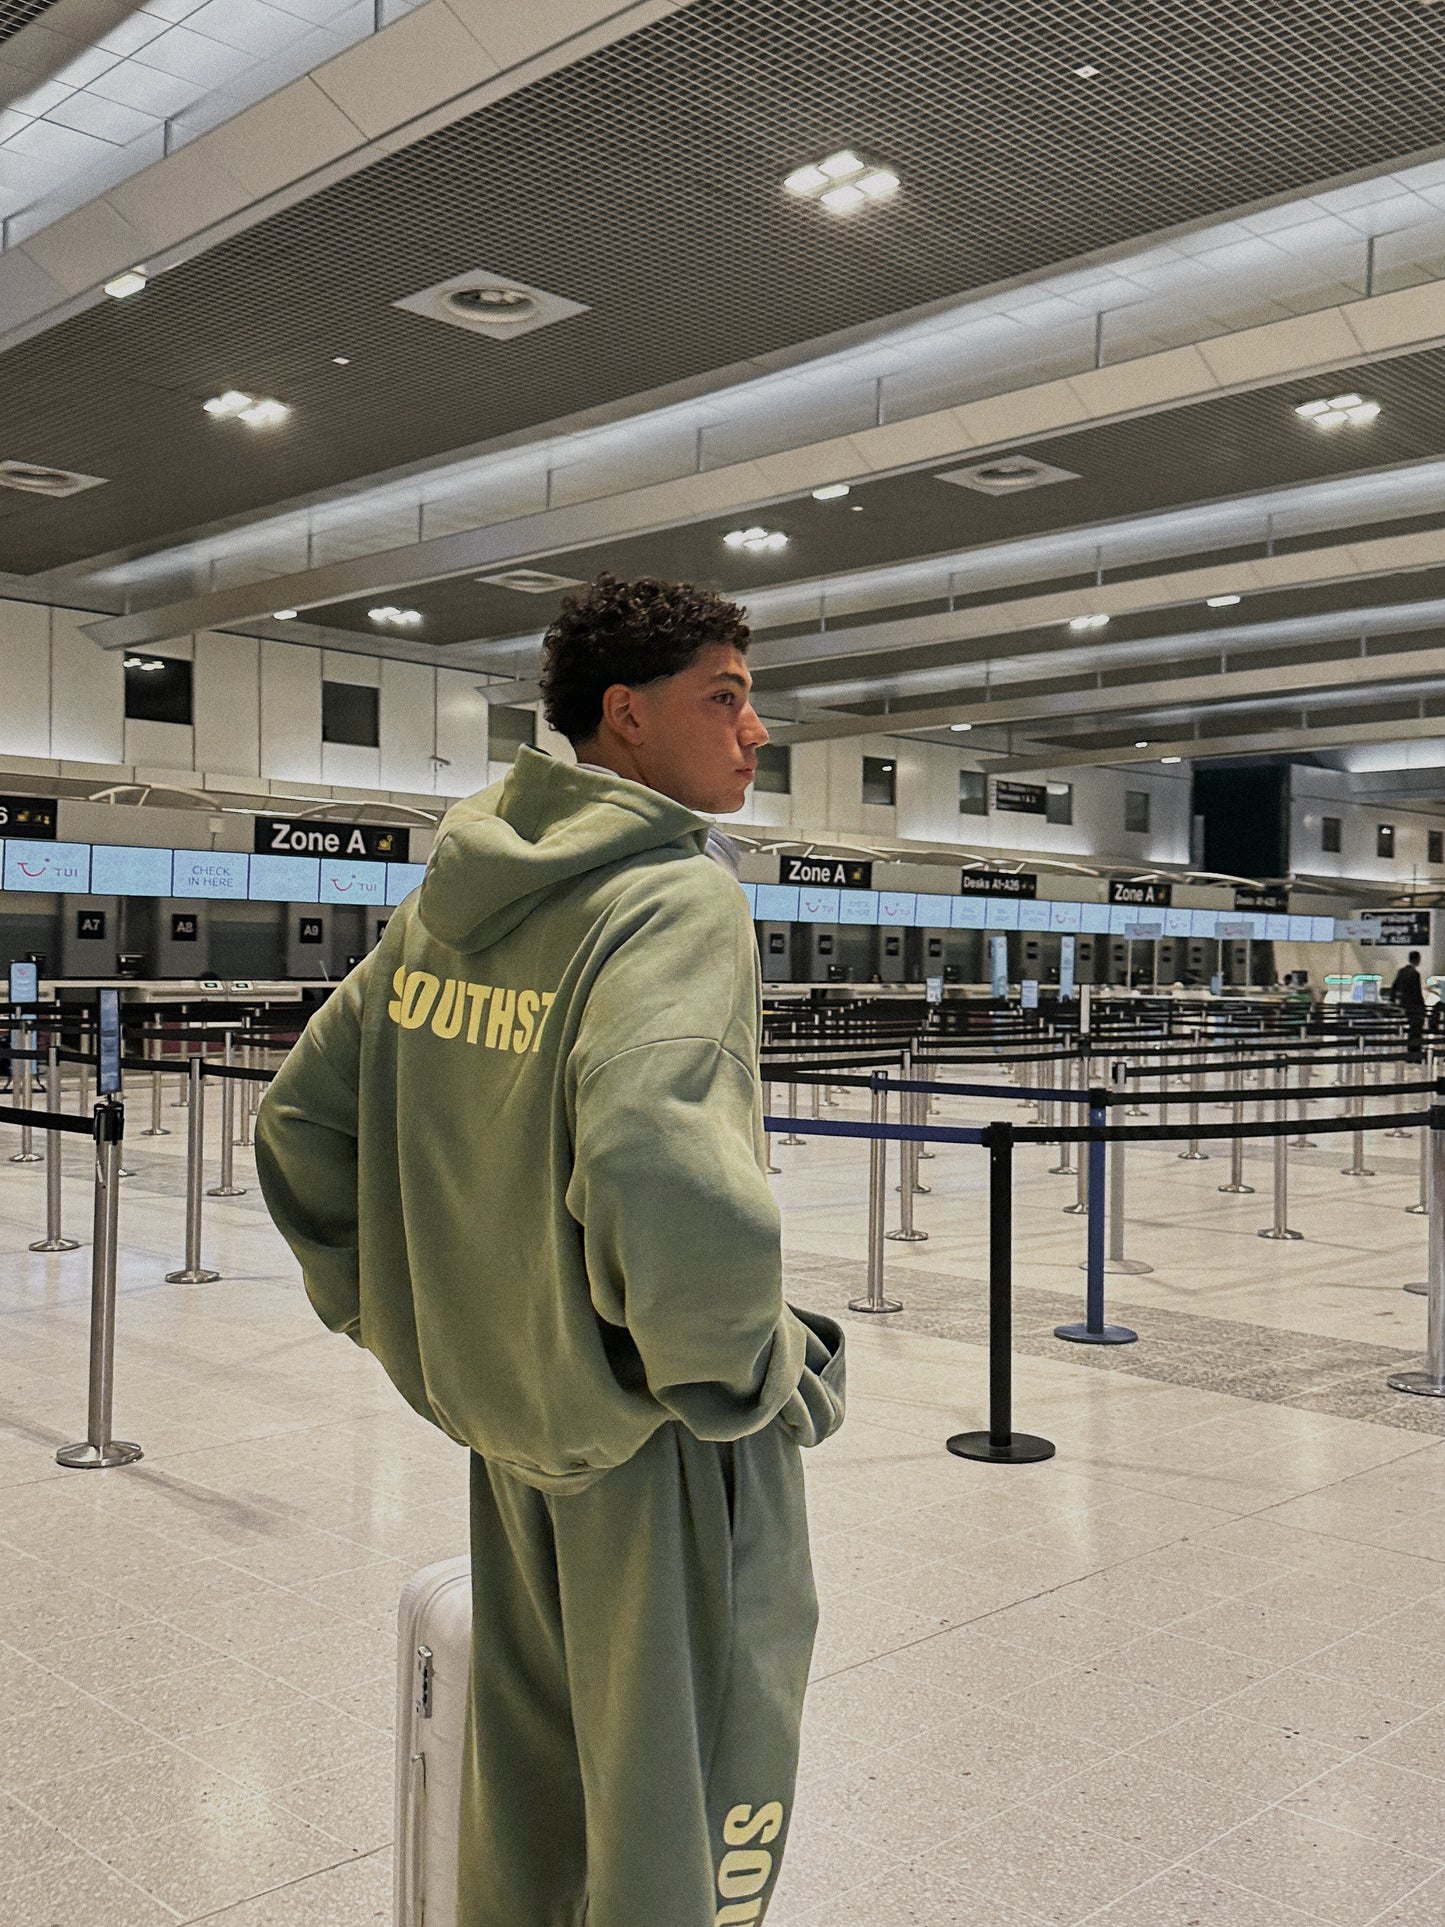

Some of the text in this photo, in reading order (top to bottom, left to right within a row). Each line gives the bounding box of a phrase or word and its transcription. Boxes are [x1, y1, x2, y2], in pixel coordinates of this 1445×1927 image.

[271, 823, 366, 854] Zone A
[54, 867, 78, 877] TUI
[192, 865, 231, 876] CHECK
[789, 861, 846, 883] Zone A
[188, 877, 233, 887] IN HERE
[357, 882, 377, 891] TUI
[963, 876, 990, 889] Desks
[1115, 883, 1154, 902] Zone A
[82, 919, 100, 930] A7
[304, 925, 319, 936] A9
